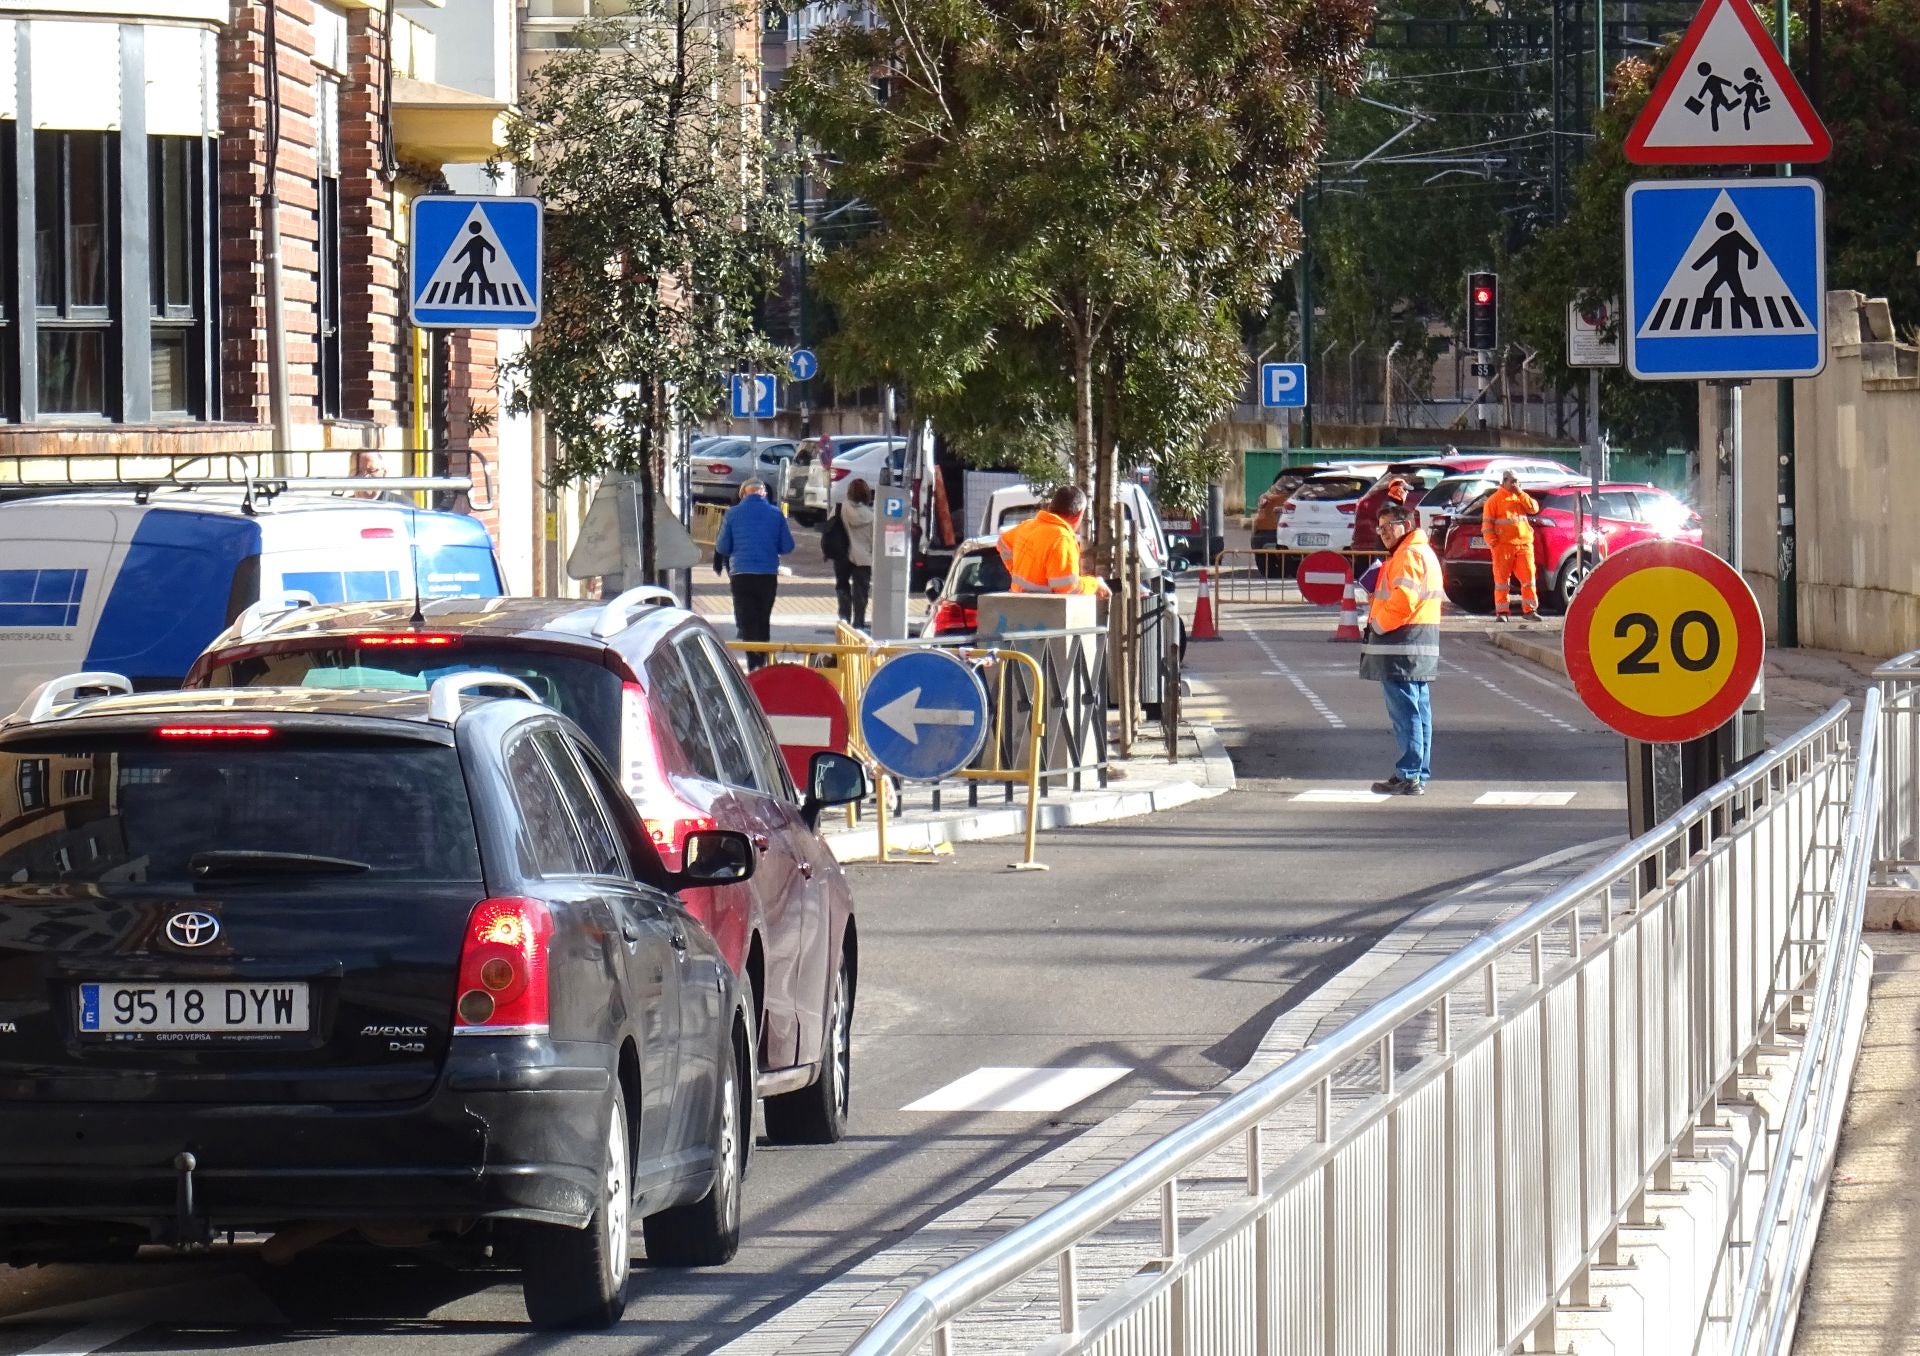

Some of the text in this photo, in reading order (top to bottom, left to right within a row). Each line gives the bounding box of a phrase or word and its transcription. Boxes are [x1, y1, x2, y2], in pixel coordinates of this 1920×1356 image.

[1477, 364, 1489, 376] S5
[1271, 369, 1297, 403] P
[741, 379, 767, 413] P
[887, 498, 901, 515] P
[1613, 609, 1721, 675] 20
[113, 988, 294, 1025] 9518 DYW
[85, 1012, 95, 1022] E
[156, 1033, 212, 1042] GRUPO VEPISA
[360, 1025, 428, 1037] AVENSIS
